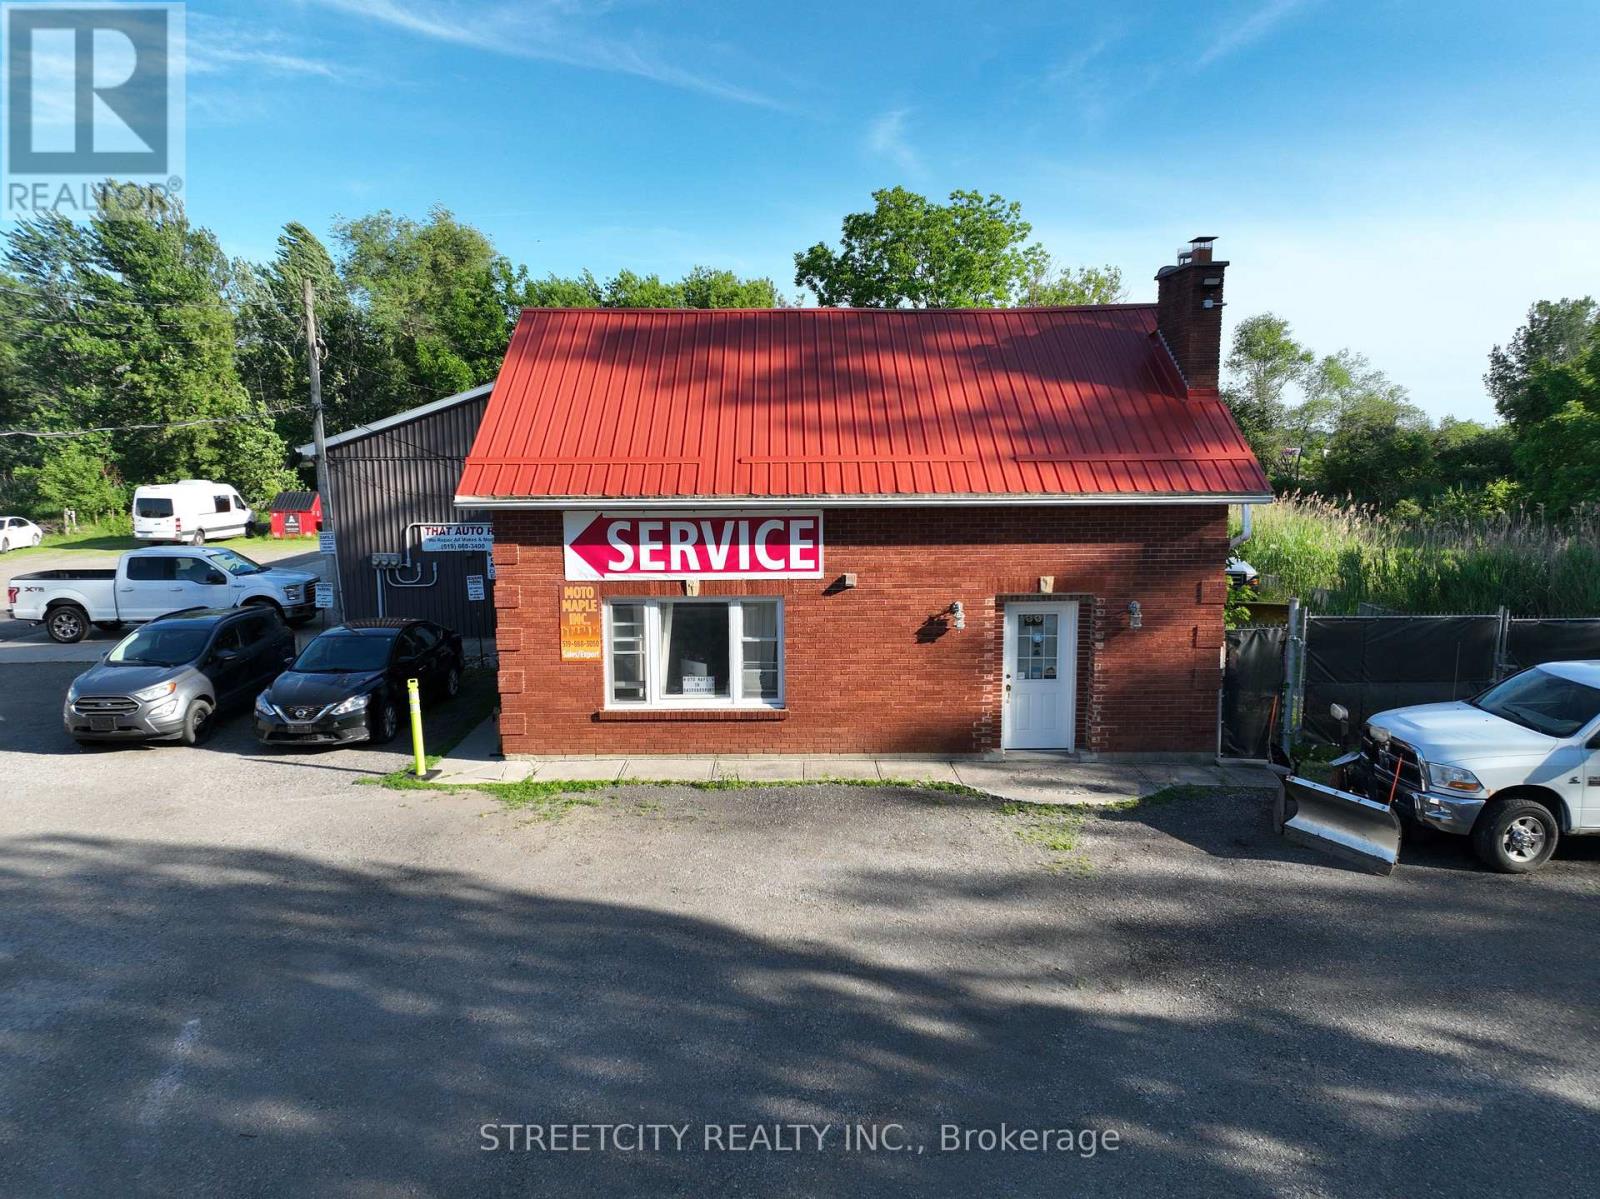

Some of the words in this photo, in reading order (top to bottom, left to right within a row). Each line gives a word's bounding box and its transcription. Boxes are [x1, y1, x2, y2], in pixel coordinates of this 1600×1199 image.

[425, 527, 452, 536] THAT
[455, 526, 484, 536] AUTO
[606, 519, 816, 572] SERVICE
[564, 586, 594, 599] MOTO
[562, 599, 598, 613] MAPLE
